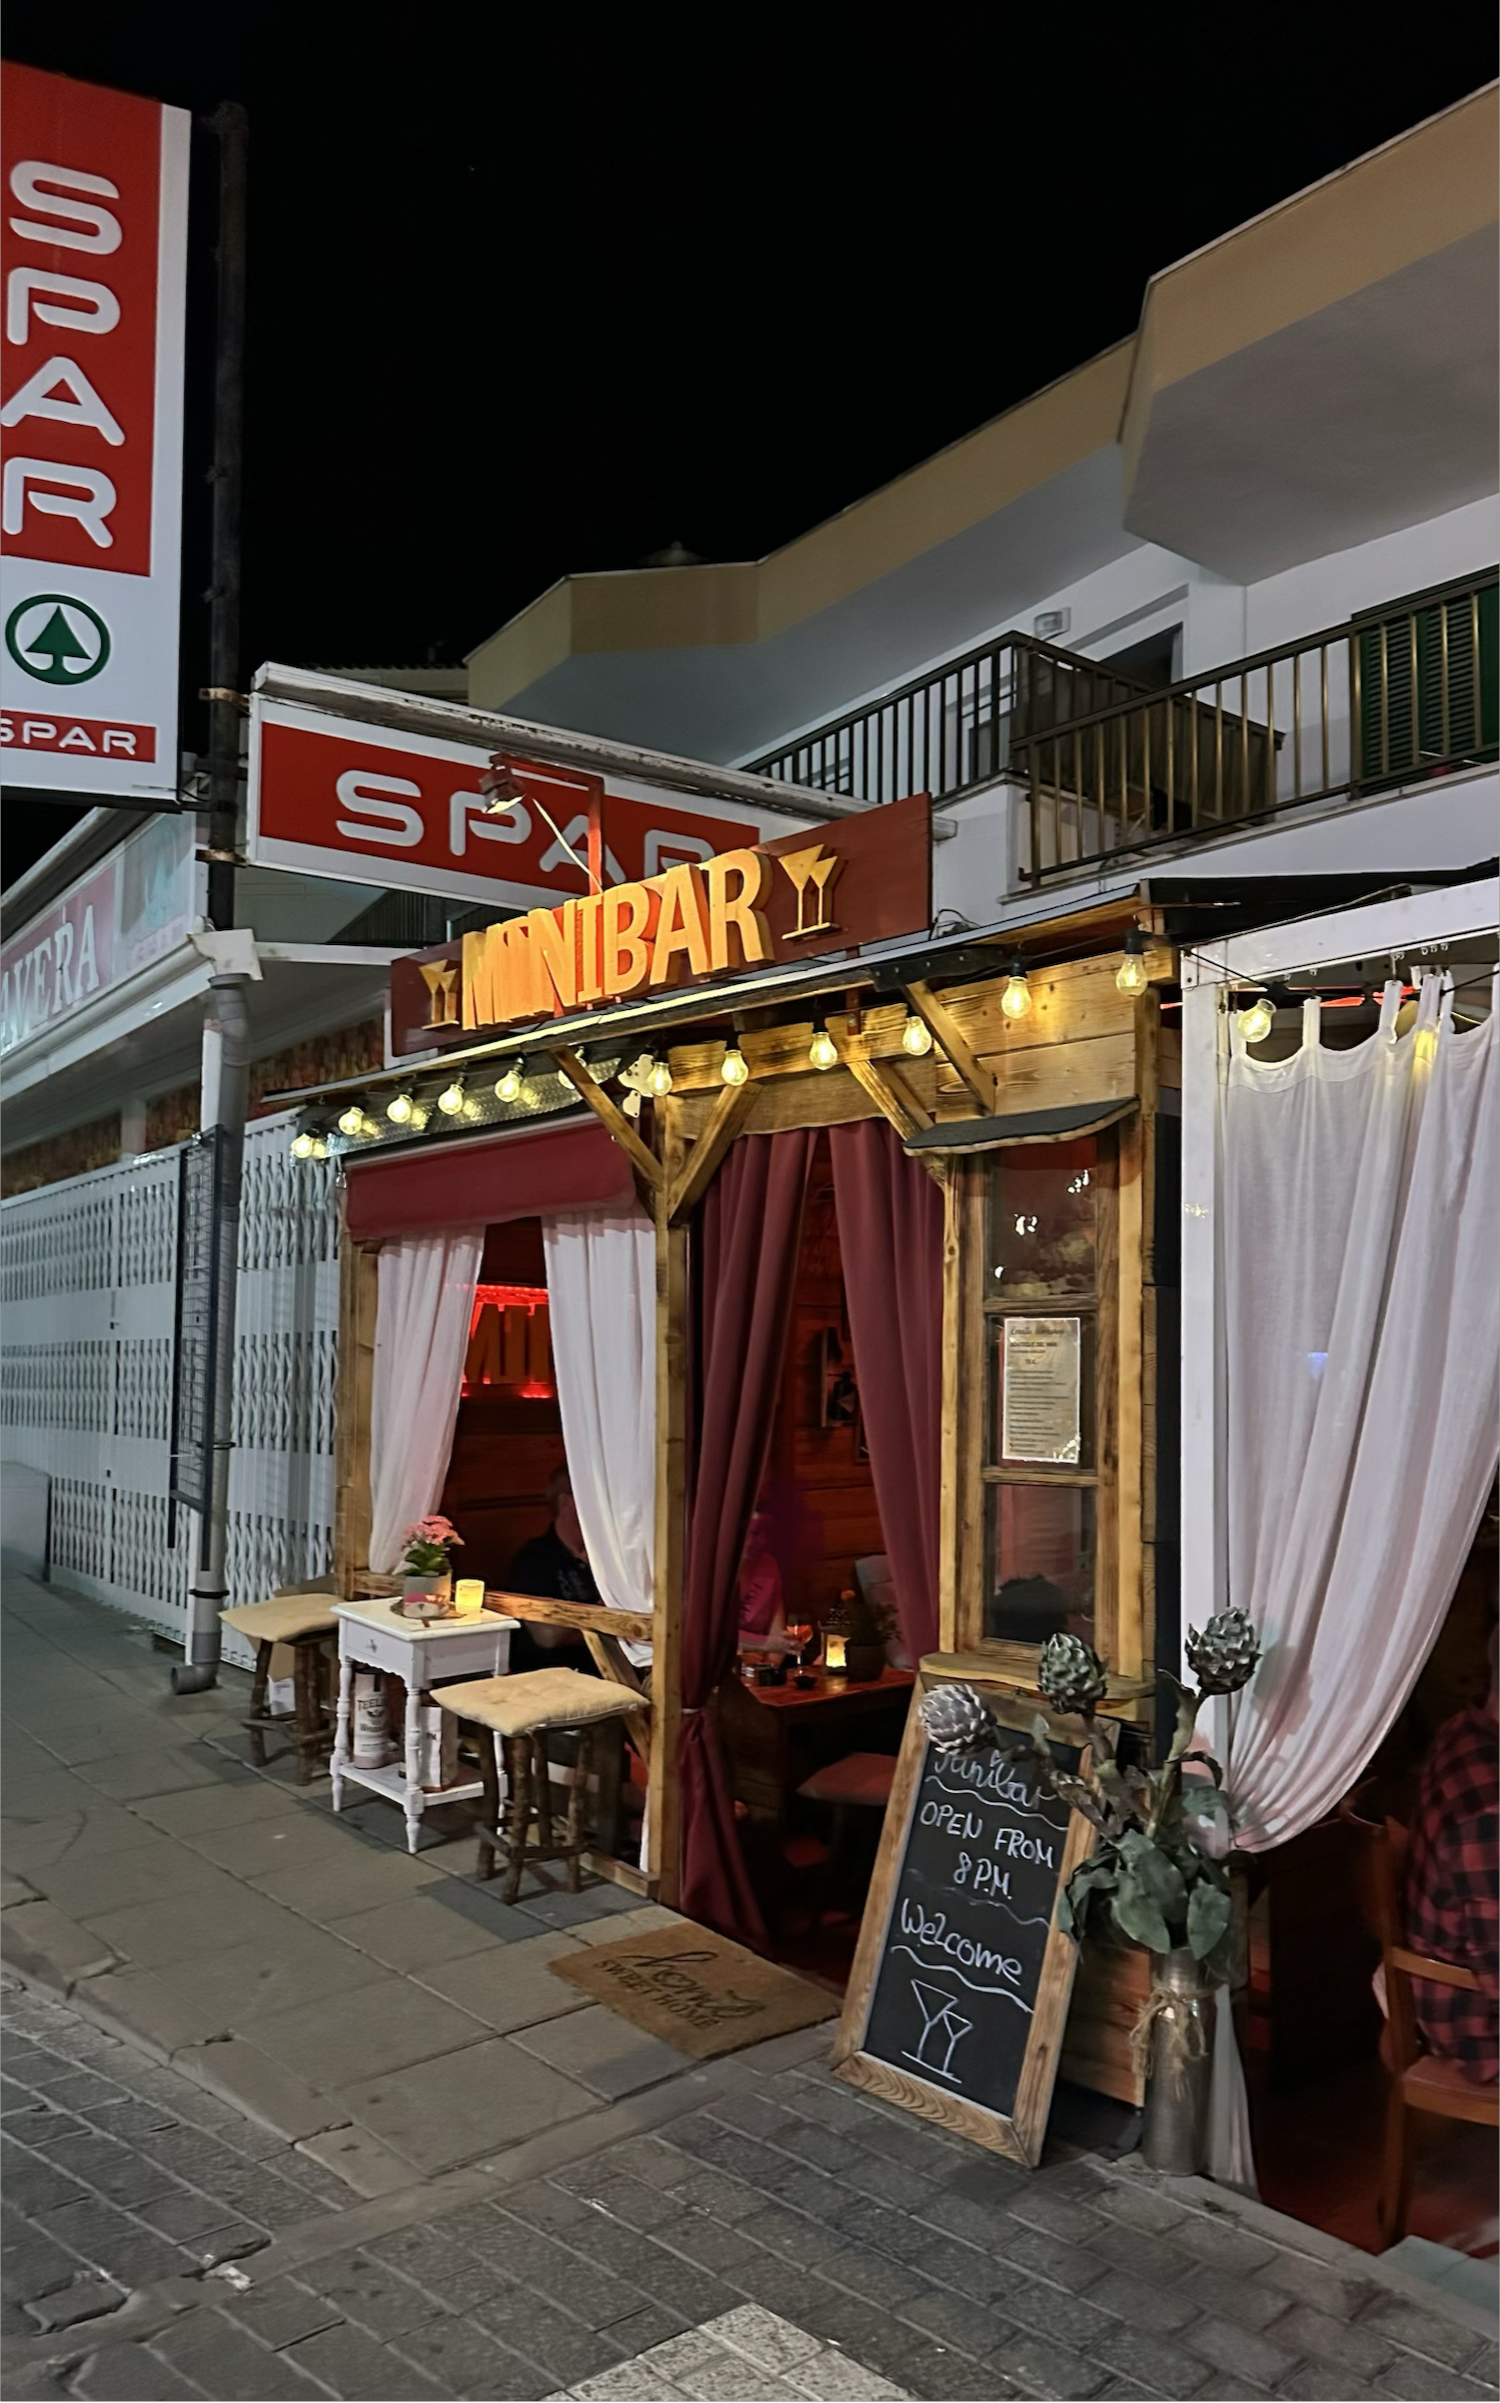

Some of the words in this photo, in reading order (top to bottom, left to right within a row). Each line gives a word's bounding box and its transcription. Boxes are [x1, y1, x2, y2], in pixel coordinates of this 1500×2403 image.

[0, 158, 125, 549] SPAR
[461, 848, 770, 1032] MINIBAR
[919, 1801, 983, 1840] OPEN
[994, 1827, 1054, 1869] FROM
[901, 1898, 1023, 1986] Welcome
[651, 1992, 721, 2030] HOME
